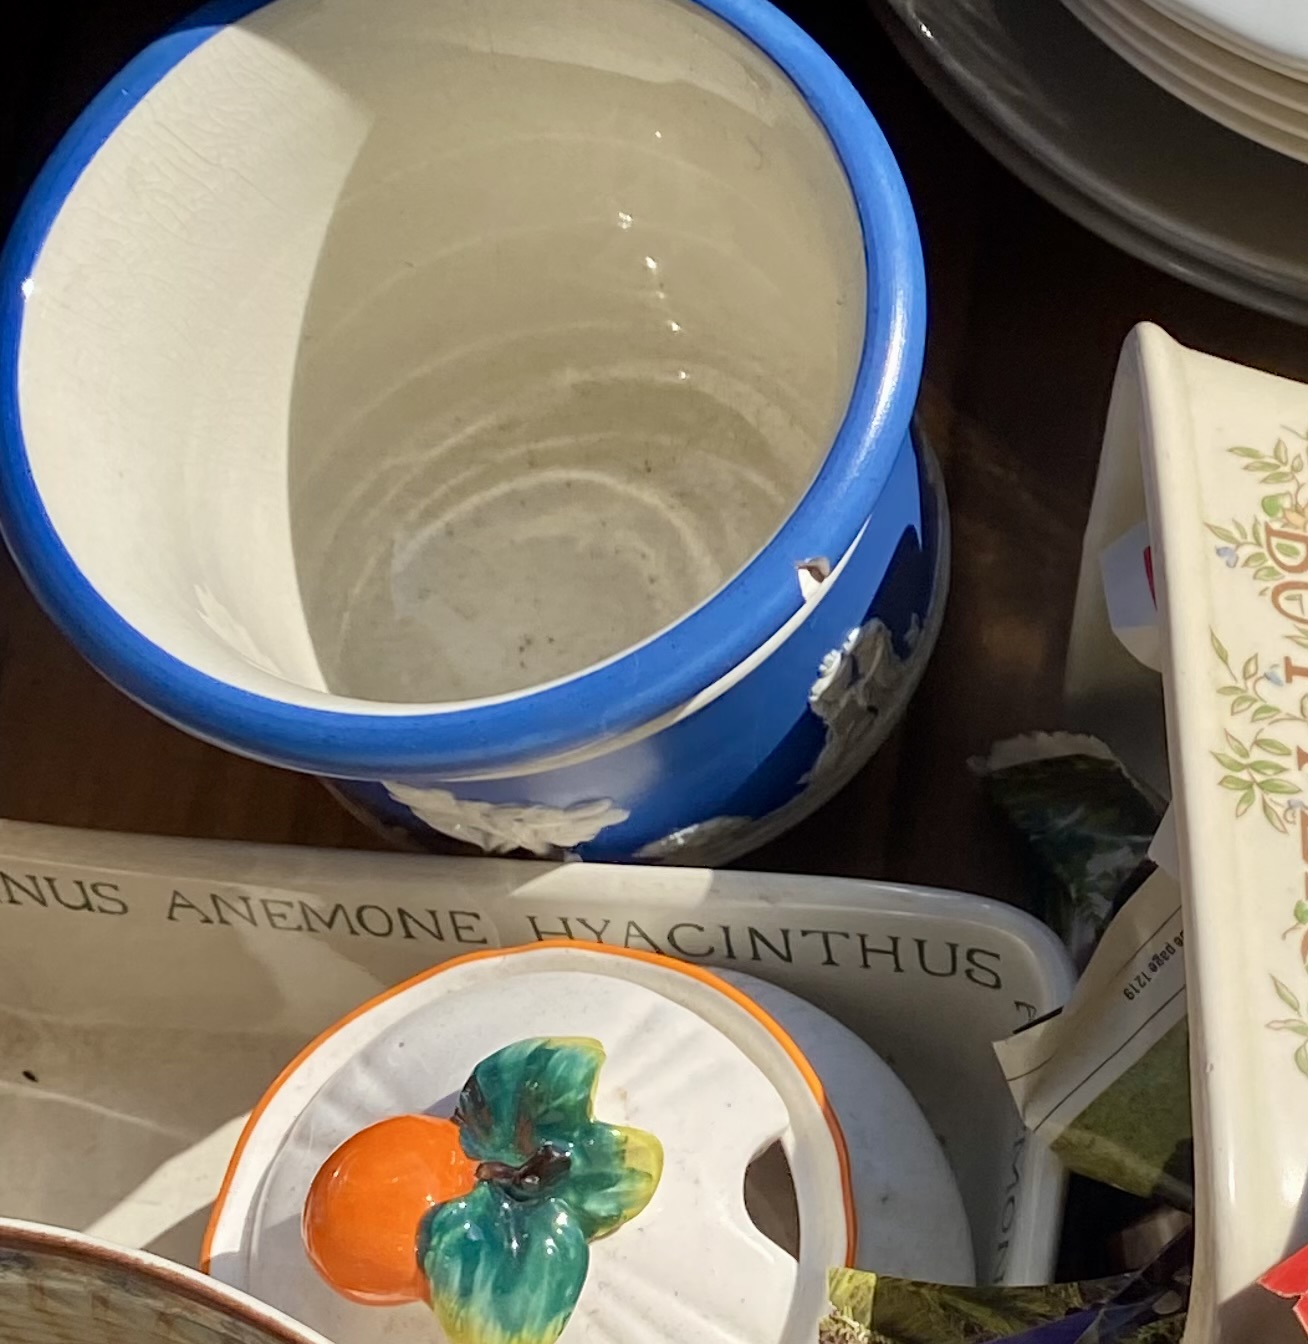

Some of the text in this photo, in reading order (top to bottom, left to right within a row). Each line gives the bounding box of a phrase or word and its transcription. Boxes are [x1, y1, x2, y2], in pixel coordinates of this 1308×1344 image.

[167, 888, 488, 946] ANEMONE
[526, 914, 1003, 991] HYACINTHUS
[1147, 942, 1176, 972] page
[1123, 971, 1153, 1001] 1219
